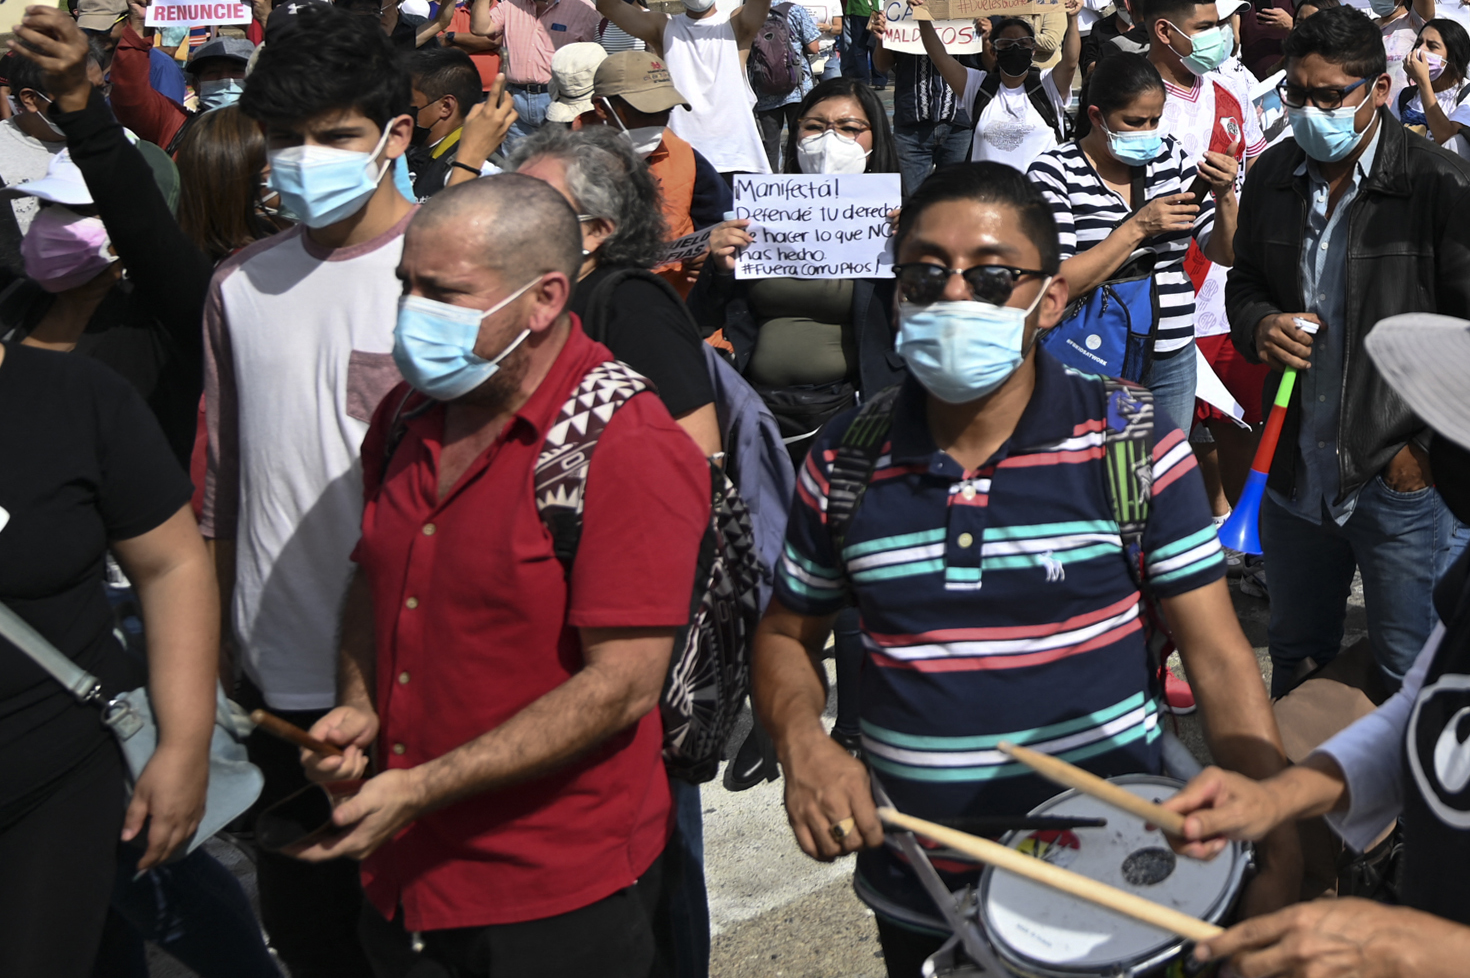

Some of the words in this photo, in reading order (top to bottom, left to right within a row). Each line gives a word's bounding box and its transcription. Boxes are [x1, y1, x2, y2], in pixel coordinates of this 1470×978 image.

[153, 3, 245, 21] RENUNCIE
[763, 226, 810, 244] hacer
[815, 228, 832, 242] lo
[834, 229, 863, 244] que
